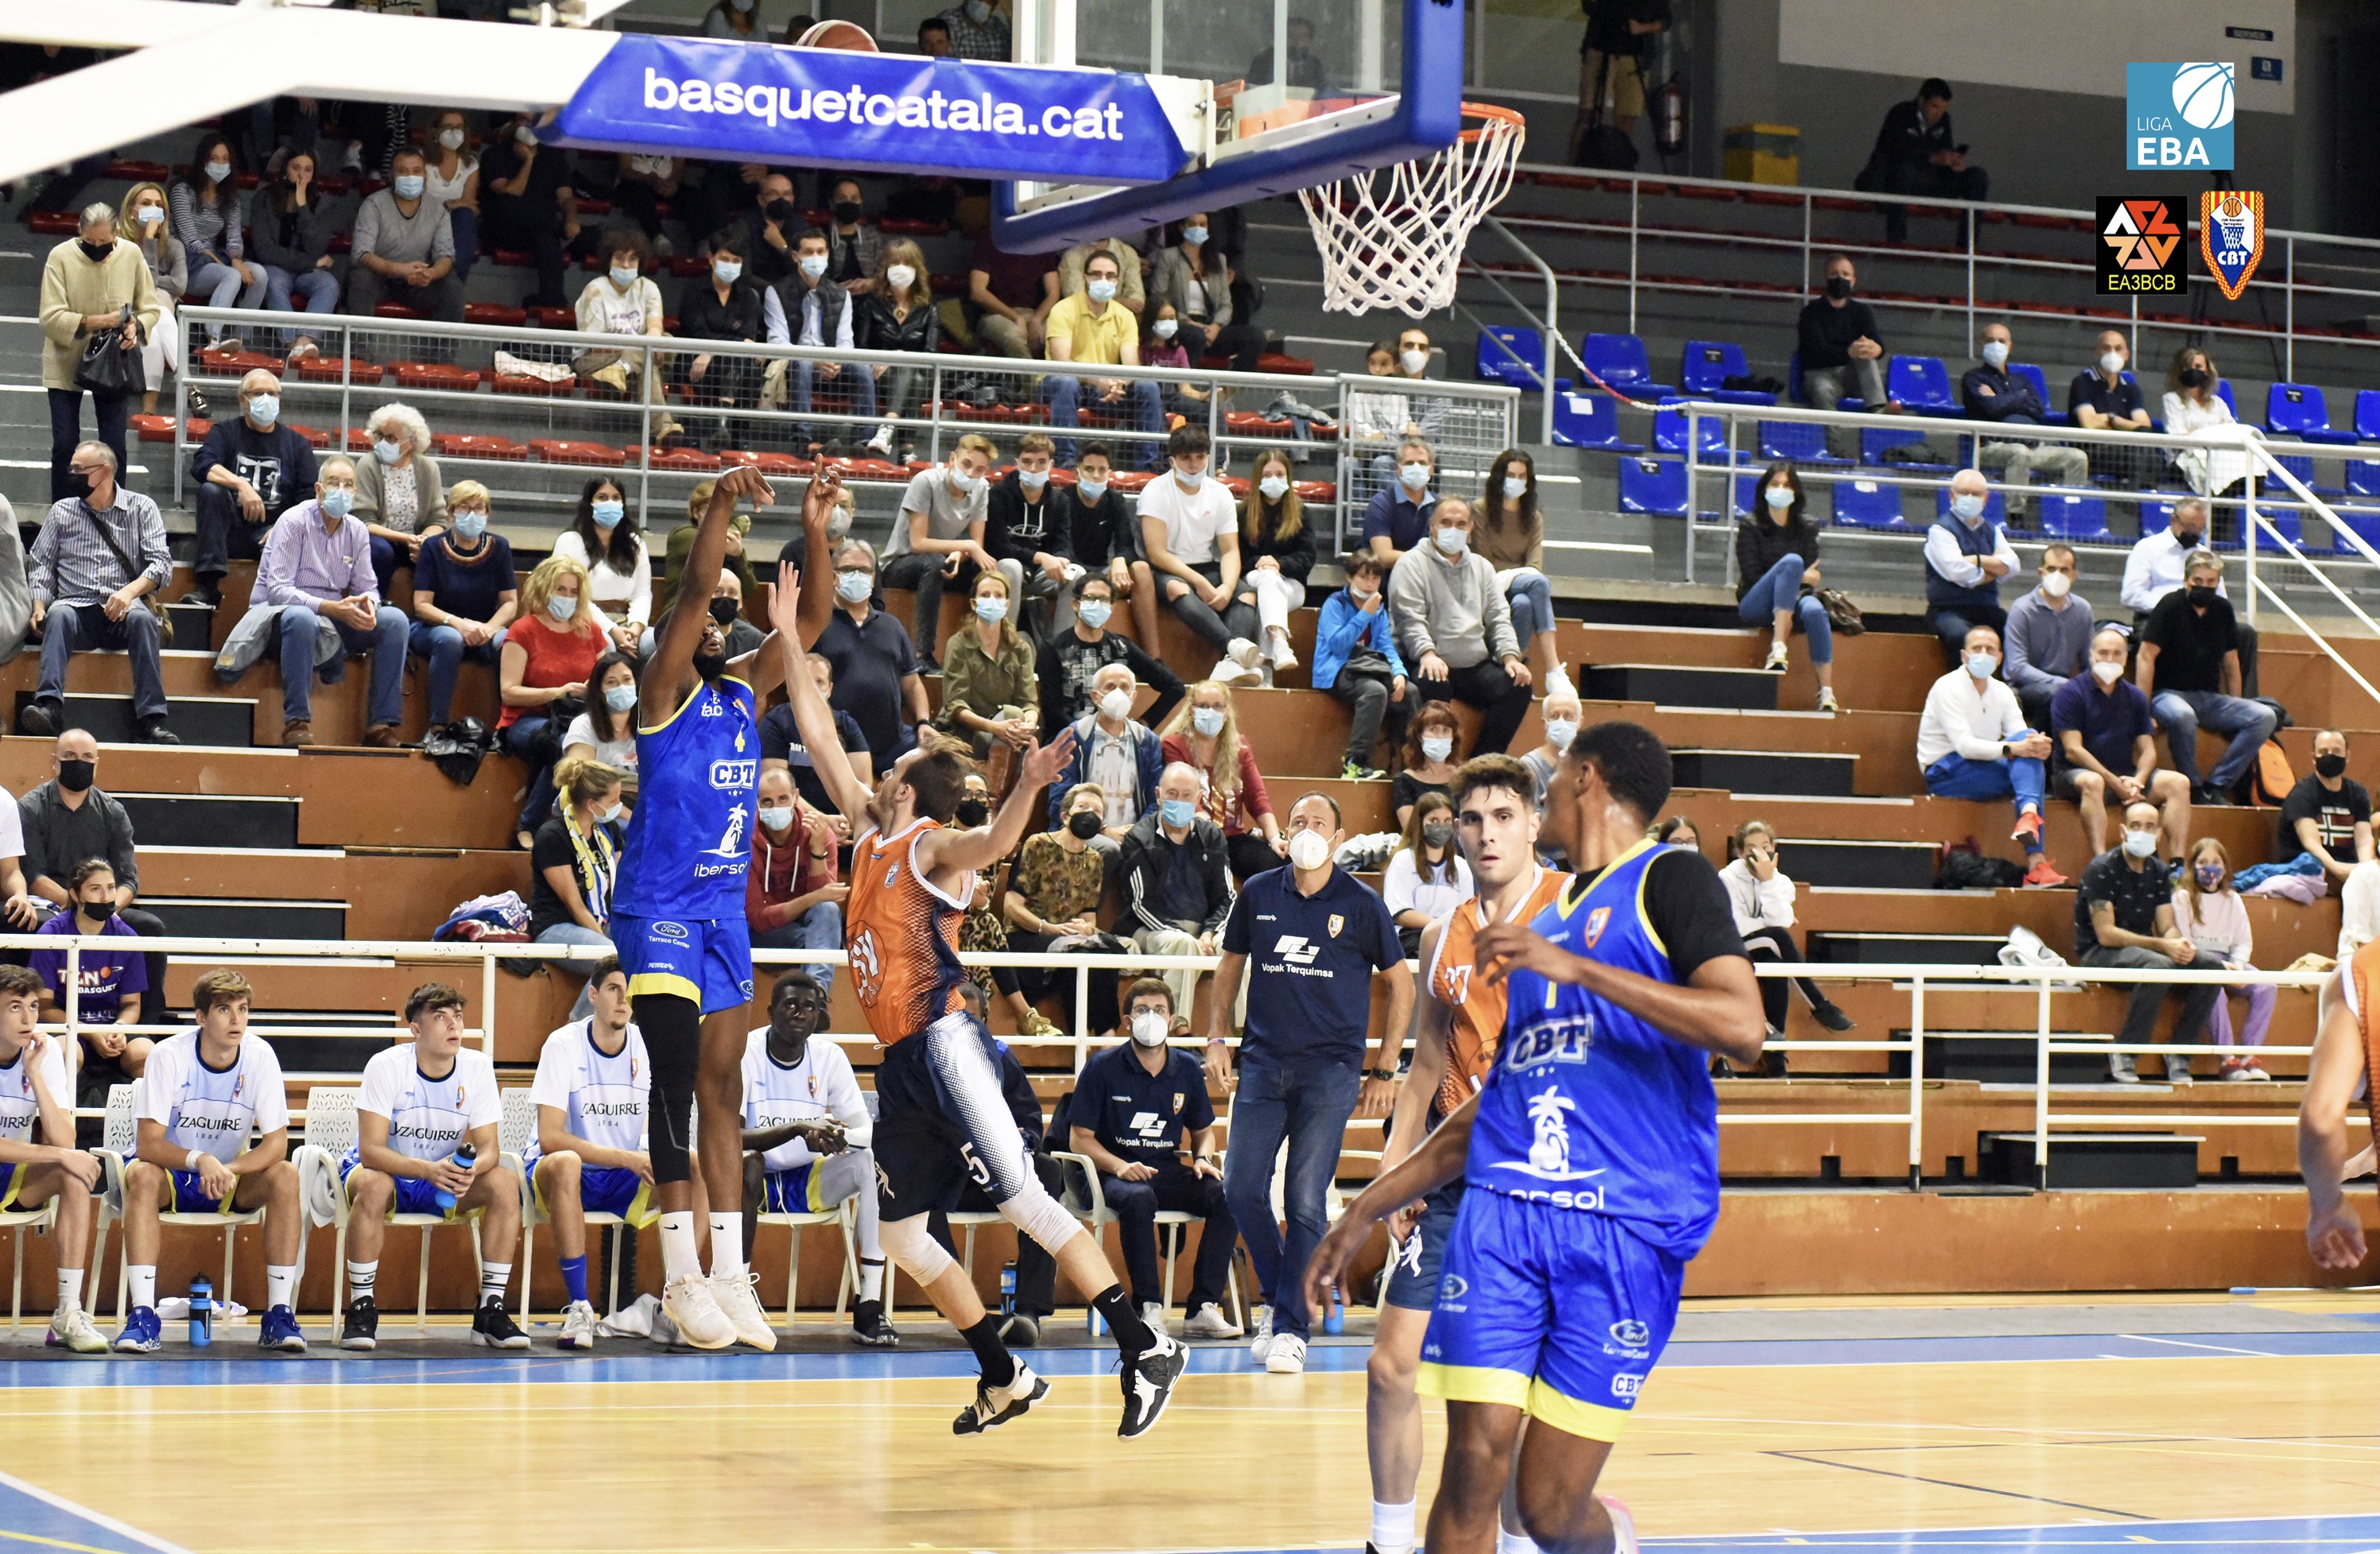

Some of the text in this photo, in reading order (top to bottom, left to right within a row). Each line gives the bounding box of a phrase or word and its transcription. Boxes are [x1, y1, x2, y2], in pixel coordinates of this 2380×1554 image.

[644, 68, 1124, 141] basquetcatala.cat
[735, 724, 746, 752] 4
[712, 761, 755, 787] CBT
[673, 938, 690, 949] Center
[57, 969, 100, 986] TN
[1262, 963, 1333, 978] Vopak Terquimsa
[78, 982, 118, 994] BASQUET
[1510, 1018, 1590, 1068] CBT
[1115, 1136, 1141, 1147] Vopak
[960, 1141, 990, 1185] 5
